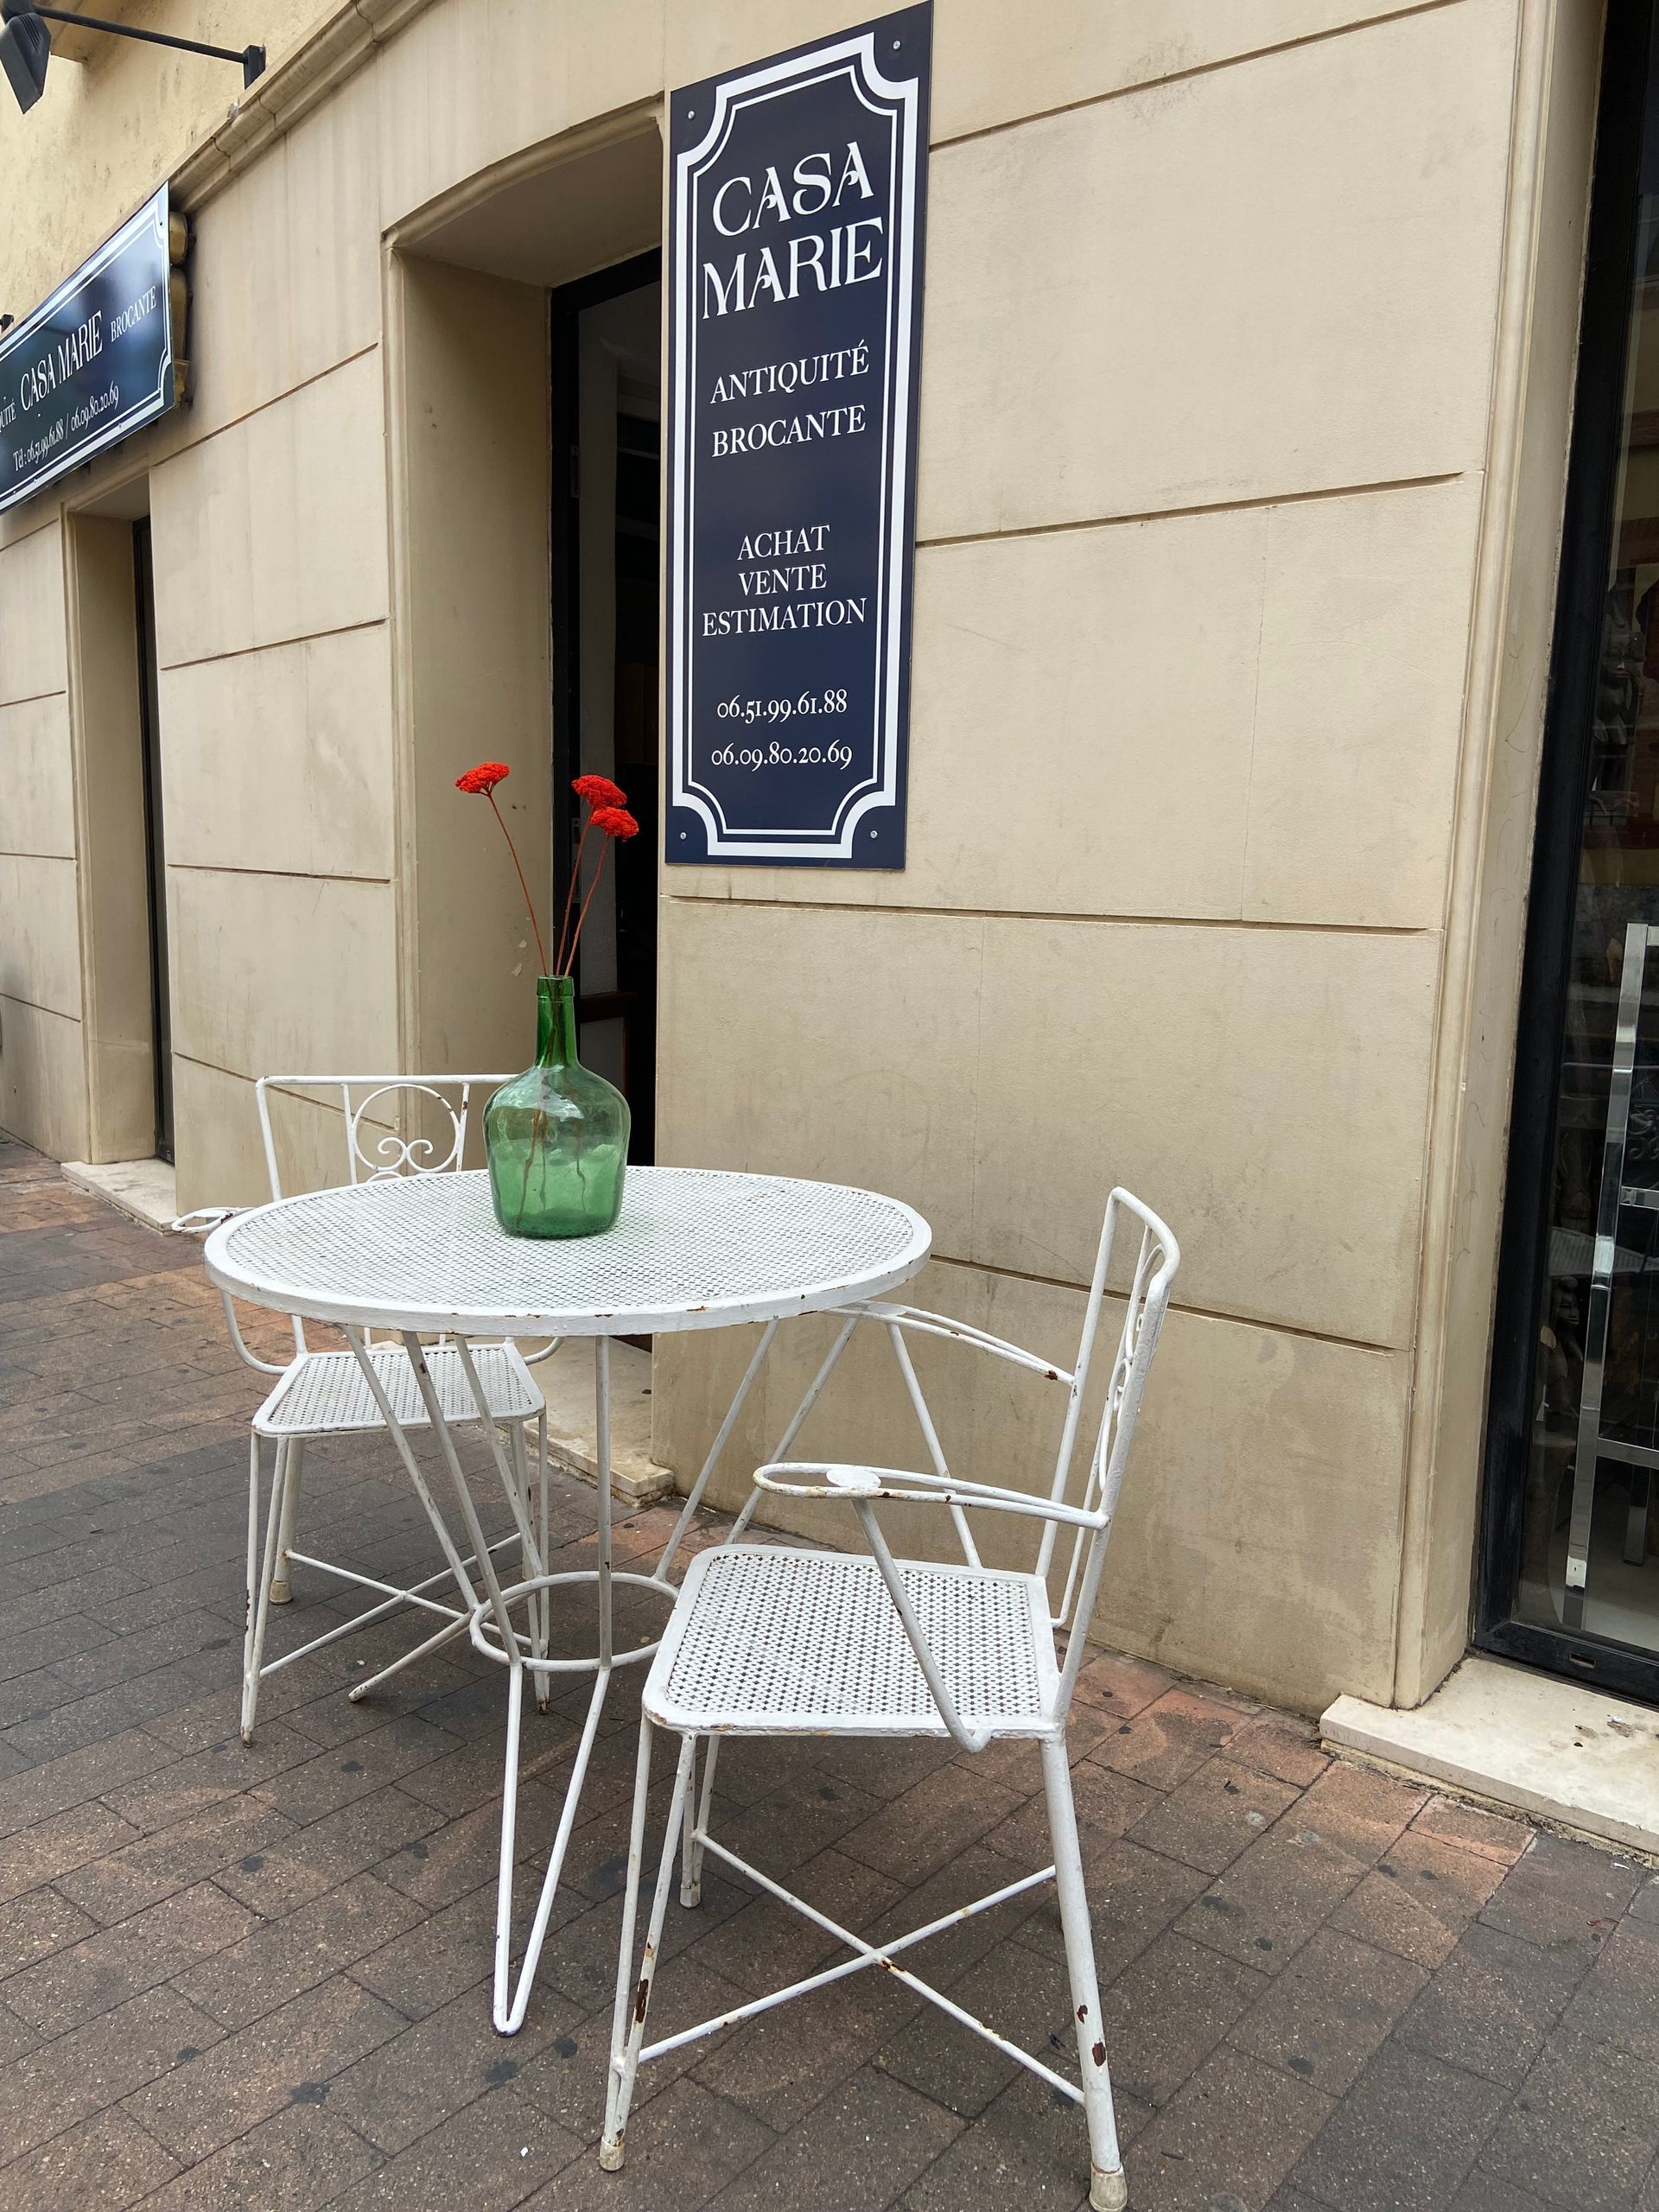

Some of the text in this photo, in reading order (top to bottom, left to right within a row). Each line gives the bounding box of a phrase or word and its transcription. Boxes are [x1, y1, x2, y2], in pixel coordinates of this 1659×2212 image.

[713, 141, 874, 236] CASA
[702, 216, 883, 320] MARIE
[0, 285, 157, 432] UITÉ CASA MARIE BROCANTE
[710, 339, 869, 404] ANTIQUITÉ
[71, 380, 119, 431] 06.09.80.20.69
[712, 404, 866, 458] BROCANTE
[737, 524, 830, 561] ACHAT
[739, 563, 827, 596] VENTE
[702, 597, 868, 637] ESTIMATION
[716, 689, 848, 724] 06.51.99.61.88
[711, 739, 853, 772] 06.09.80.20.69
